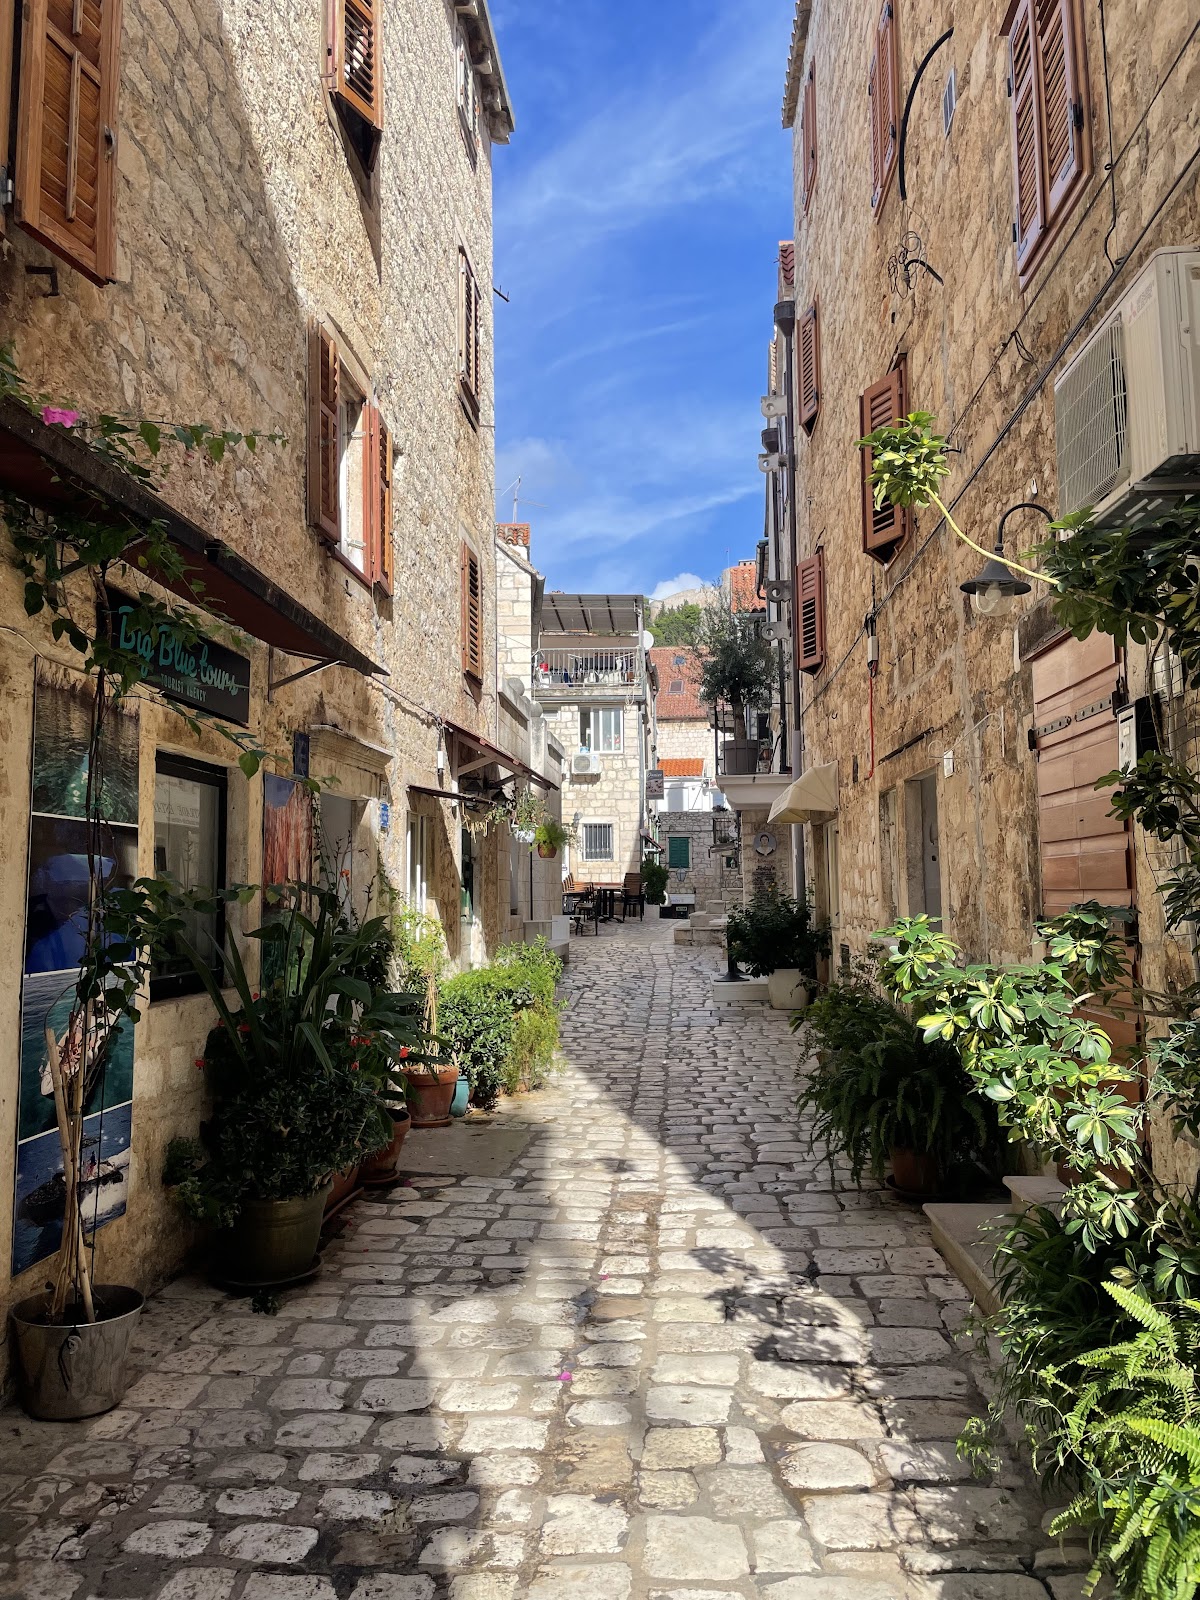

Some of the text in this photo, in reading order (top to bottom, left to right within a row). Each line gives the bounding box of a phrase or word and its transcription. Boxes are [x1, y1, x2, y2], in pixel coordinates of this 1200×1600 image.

[158, 624, 198, 678] Blue
[199, 645, 239, 696] tours
[160, 673, 184, 695] TOURIST
